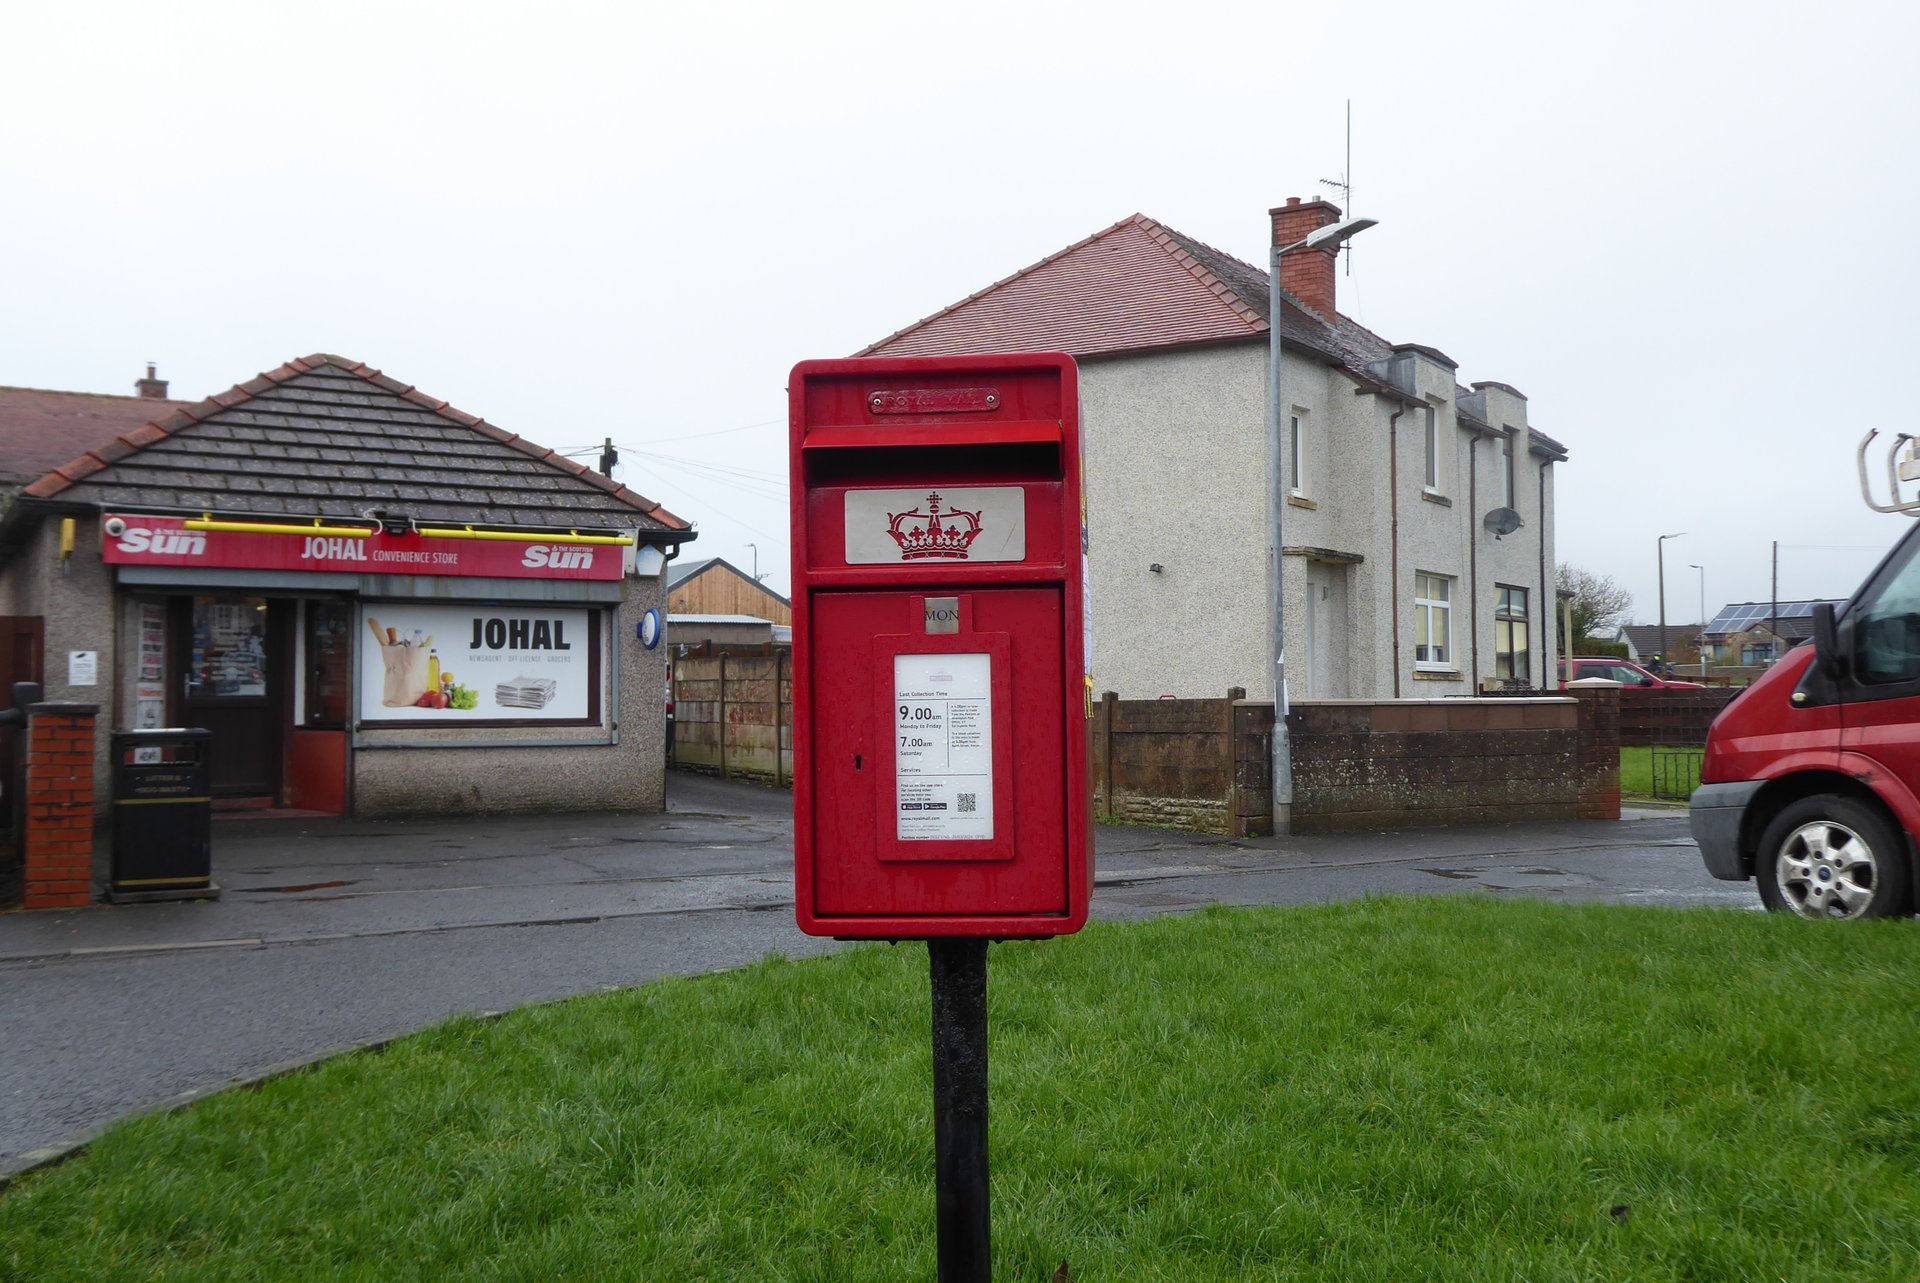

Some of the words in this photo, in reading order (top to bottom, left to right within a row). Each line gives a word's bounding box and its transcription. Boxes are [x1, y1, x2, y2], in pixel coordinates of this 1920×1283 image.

[117, 527, 207, 555] Sun
[301, 537, 367, 561] JOHAL
[373, 550, 431, 564] CONVENIENCE
[432, 552, 458, 565] STORE
[521, 545, 593, 569] Sun
[924, 609, 960, 621] MON
[470, 617, 571, 650] JOHAL
[508, 655, 518, 663] OFF
[520, 655, 541, 663] LICENSE
